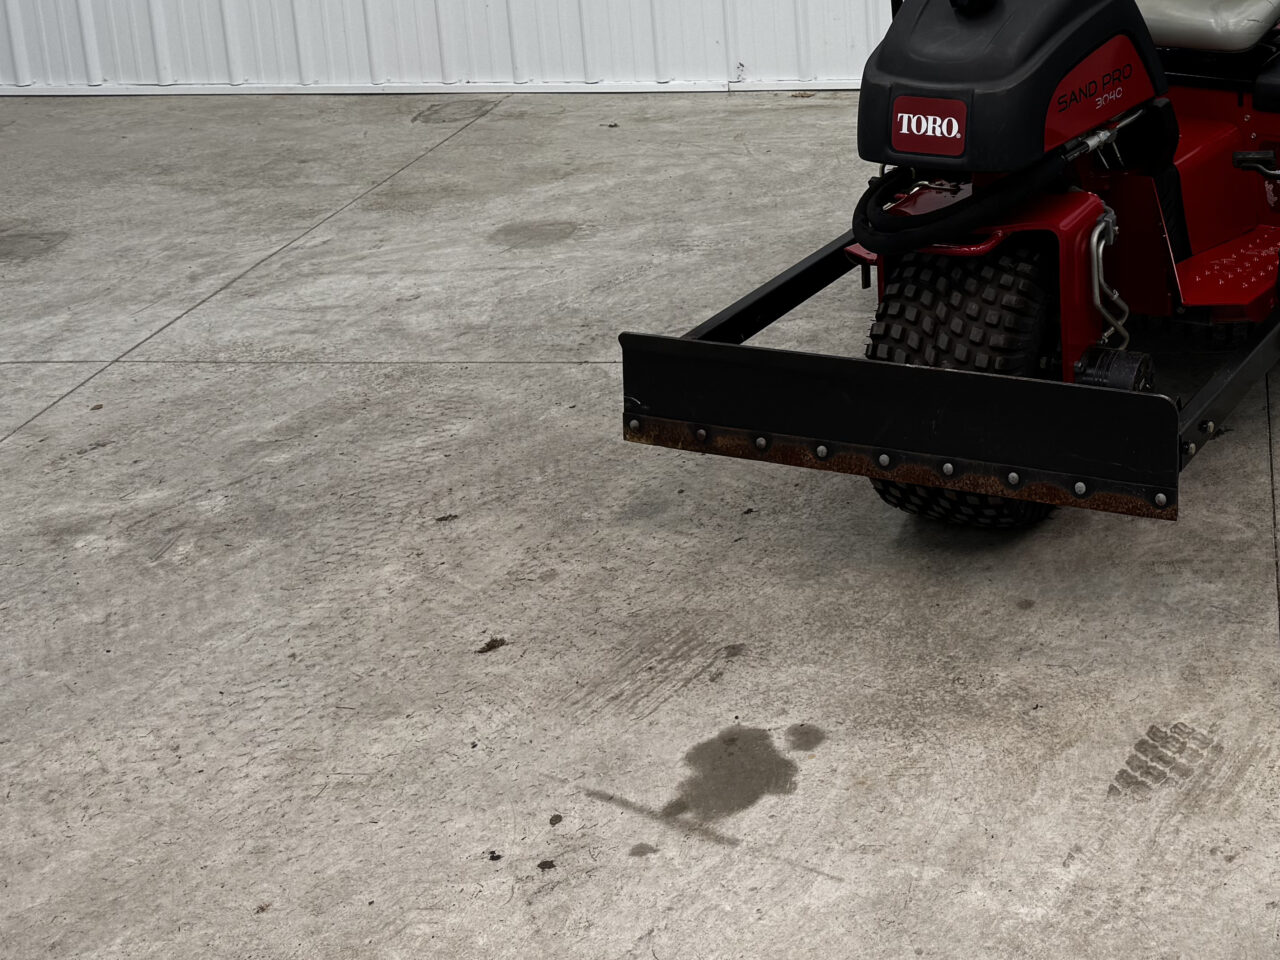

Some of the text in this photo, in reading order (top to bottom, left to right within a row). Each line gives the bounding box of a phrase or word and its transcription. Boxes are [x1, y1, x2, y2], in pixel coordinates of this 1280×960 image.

[1057, 63, 1133, 113] SAND PRO
[897, 113, 960, 138] TORO
